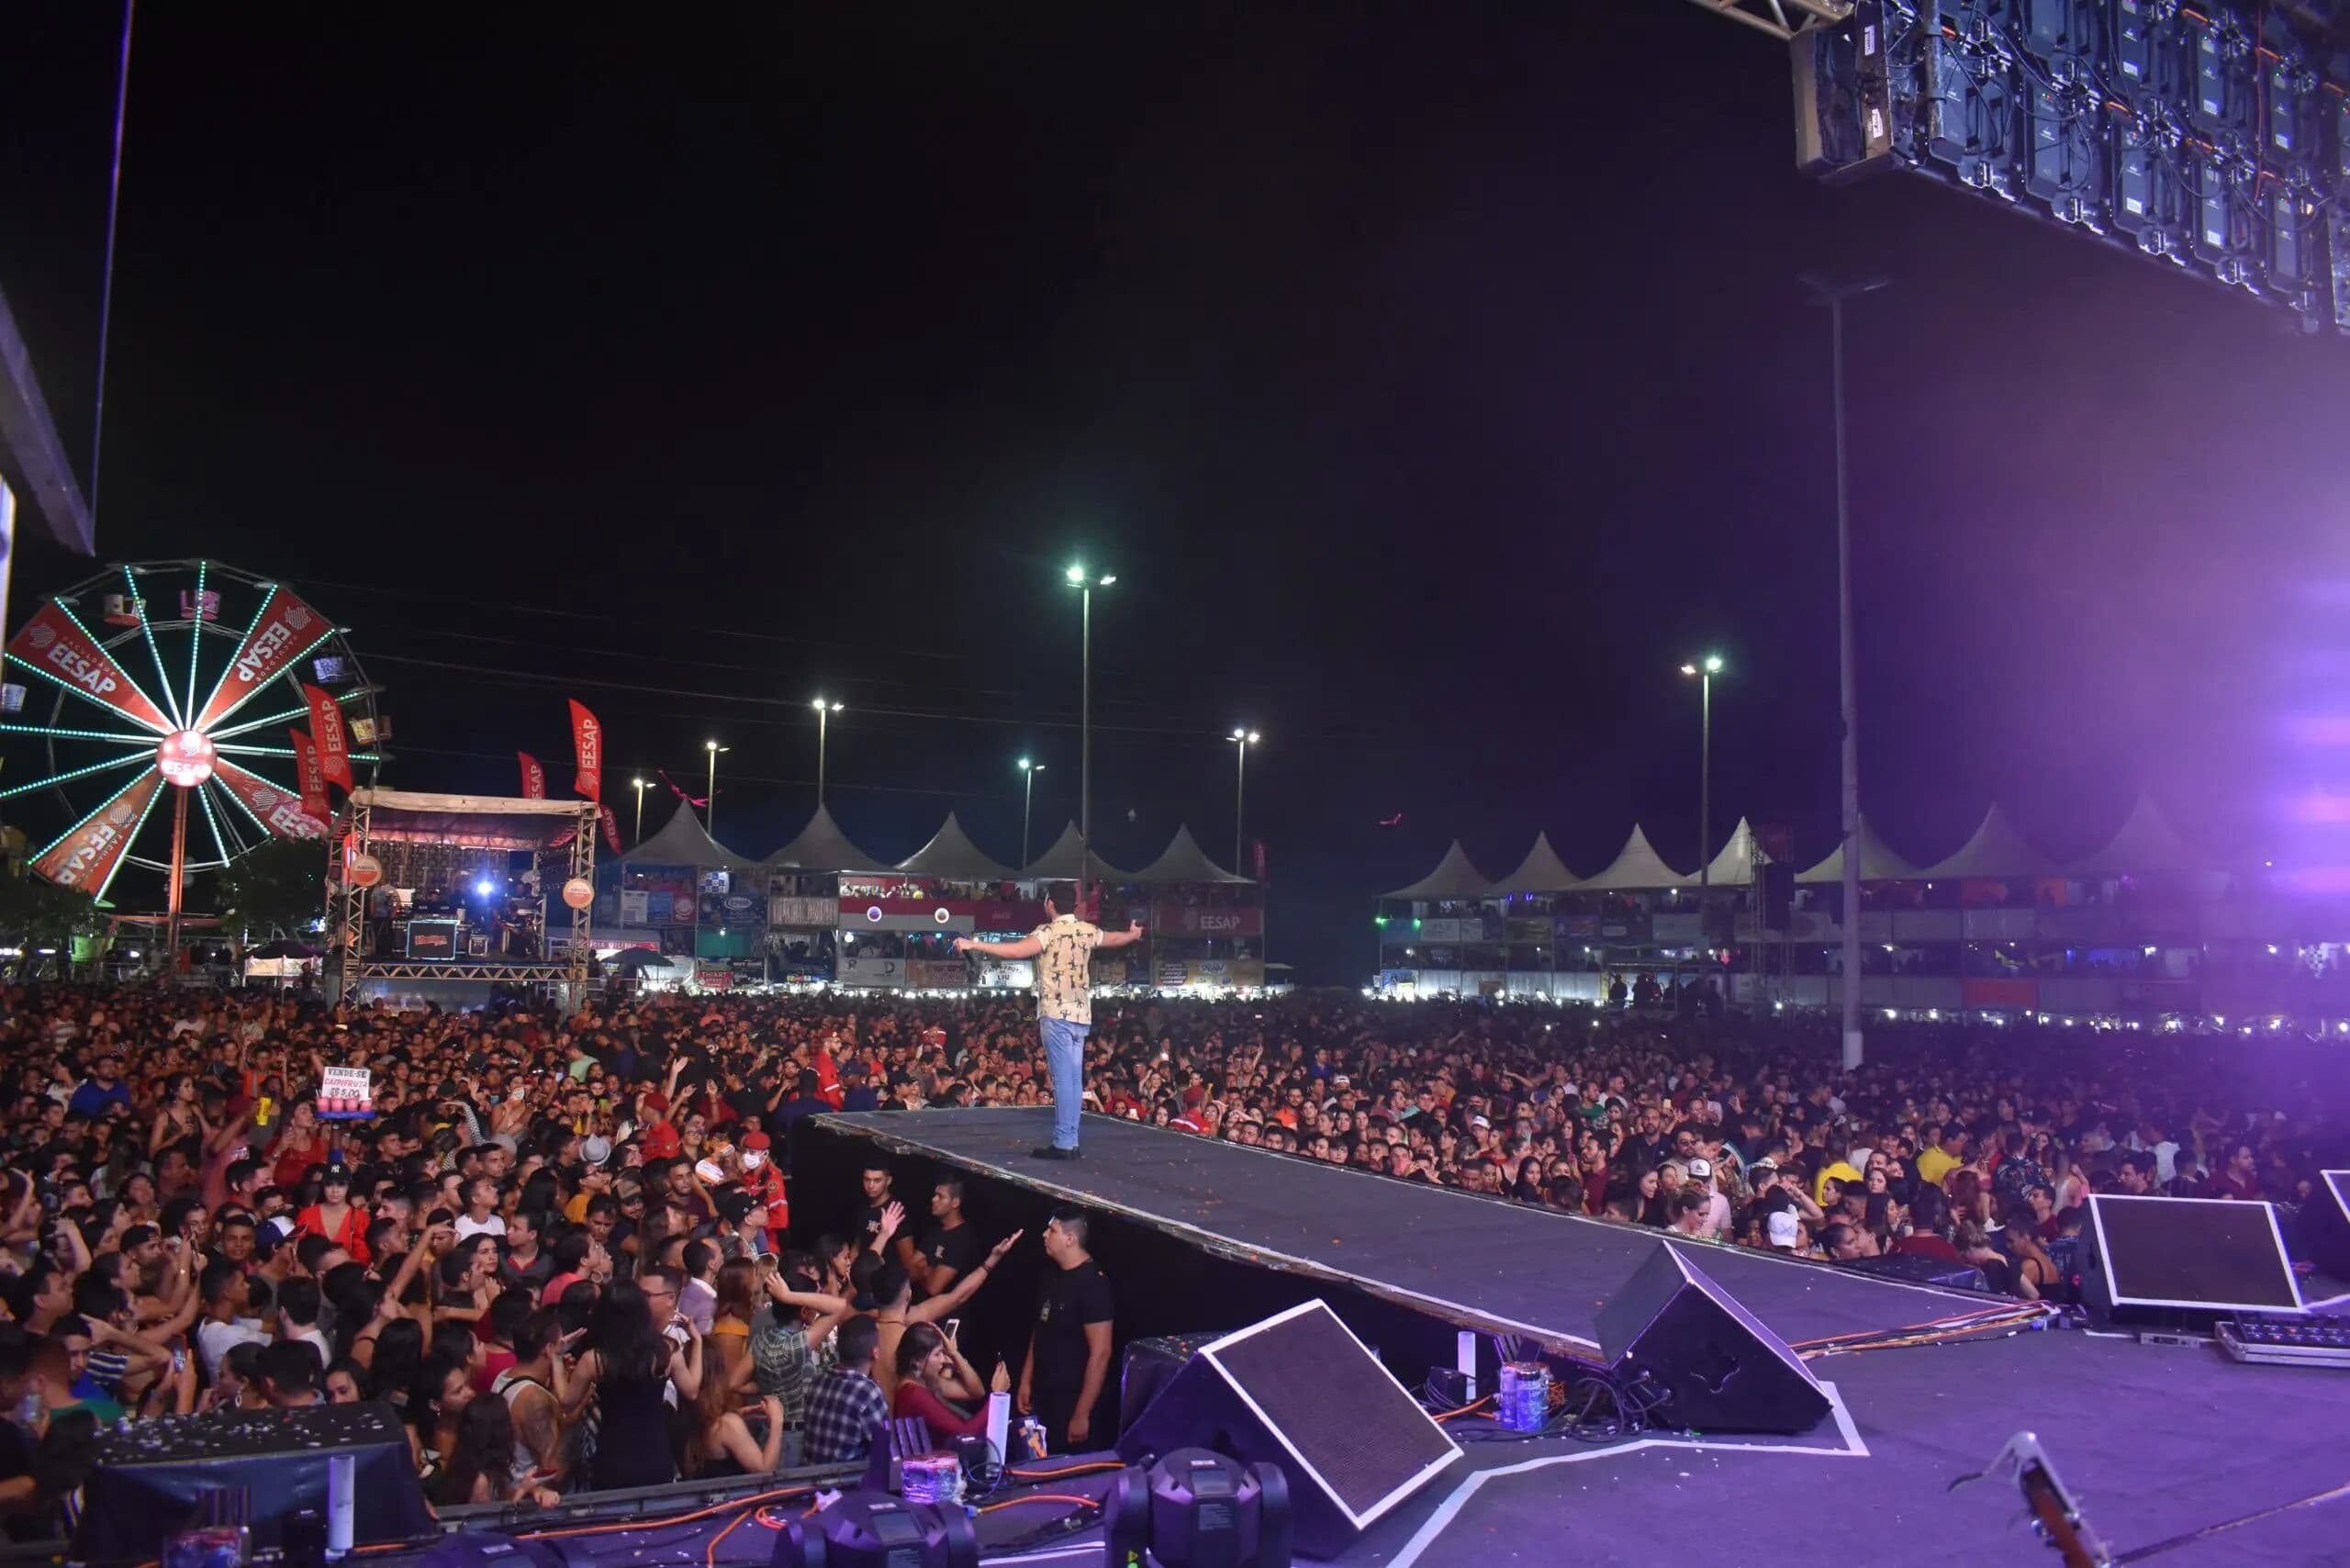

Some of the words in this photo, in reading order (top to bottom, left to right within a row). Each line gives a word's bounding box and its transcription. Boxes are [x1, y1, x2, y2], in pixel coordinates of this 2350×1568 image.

[47, 643, 117, 694] EESAP
[236, 621, 292, 682] EESAP
[322, 700, 342, 753] EESAP
[581, 719, 598, 768] EESAP
[530, 764, 543, 800] ESAP
[1200, 915, 1240, 930] EESAP
[328, 1068, 367, 1078] VENDE-SE
